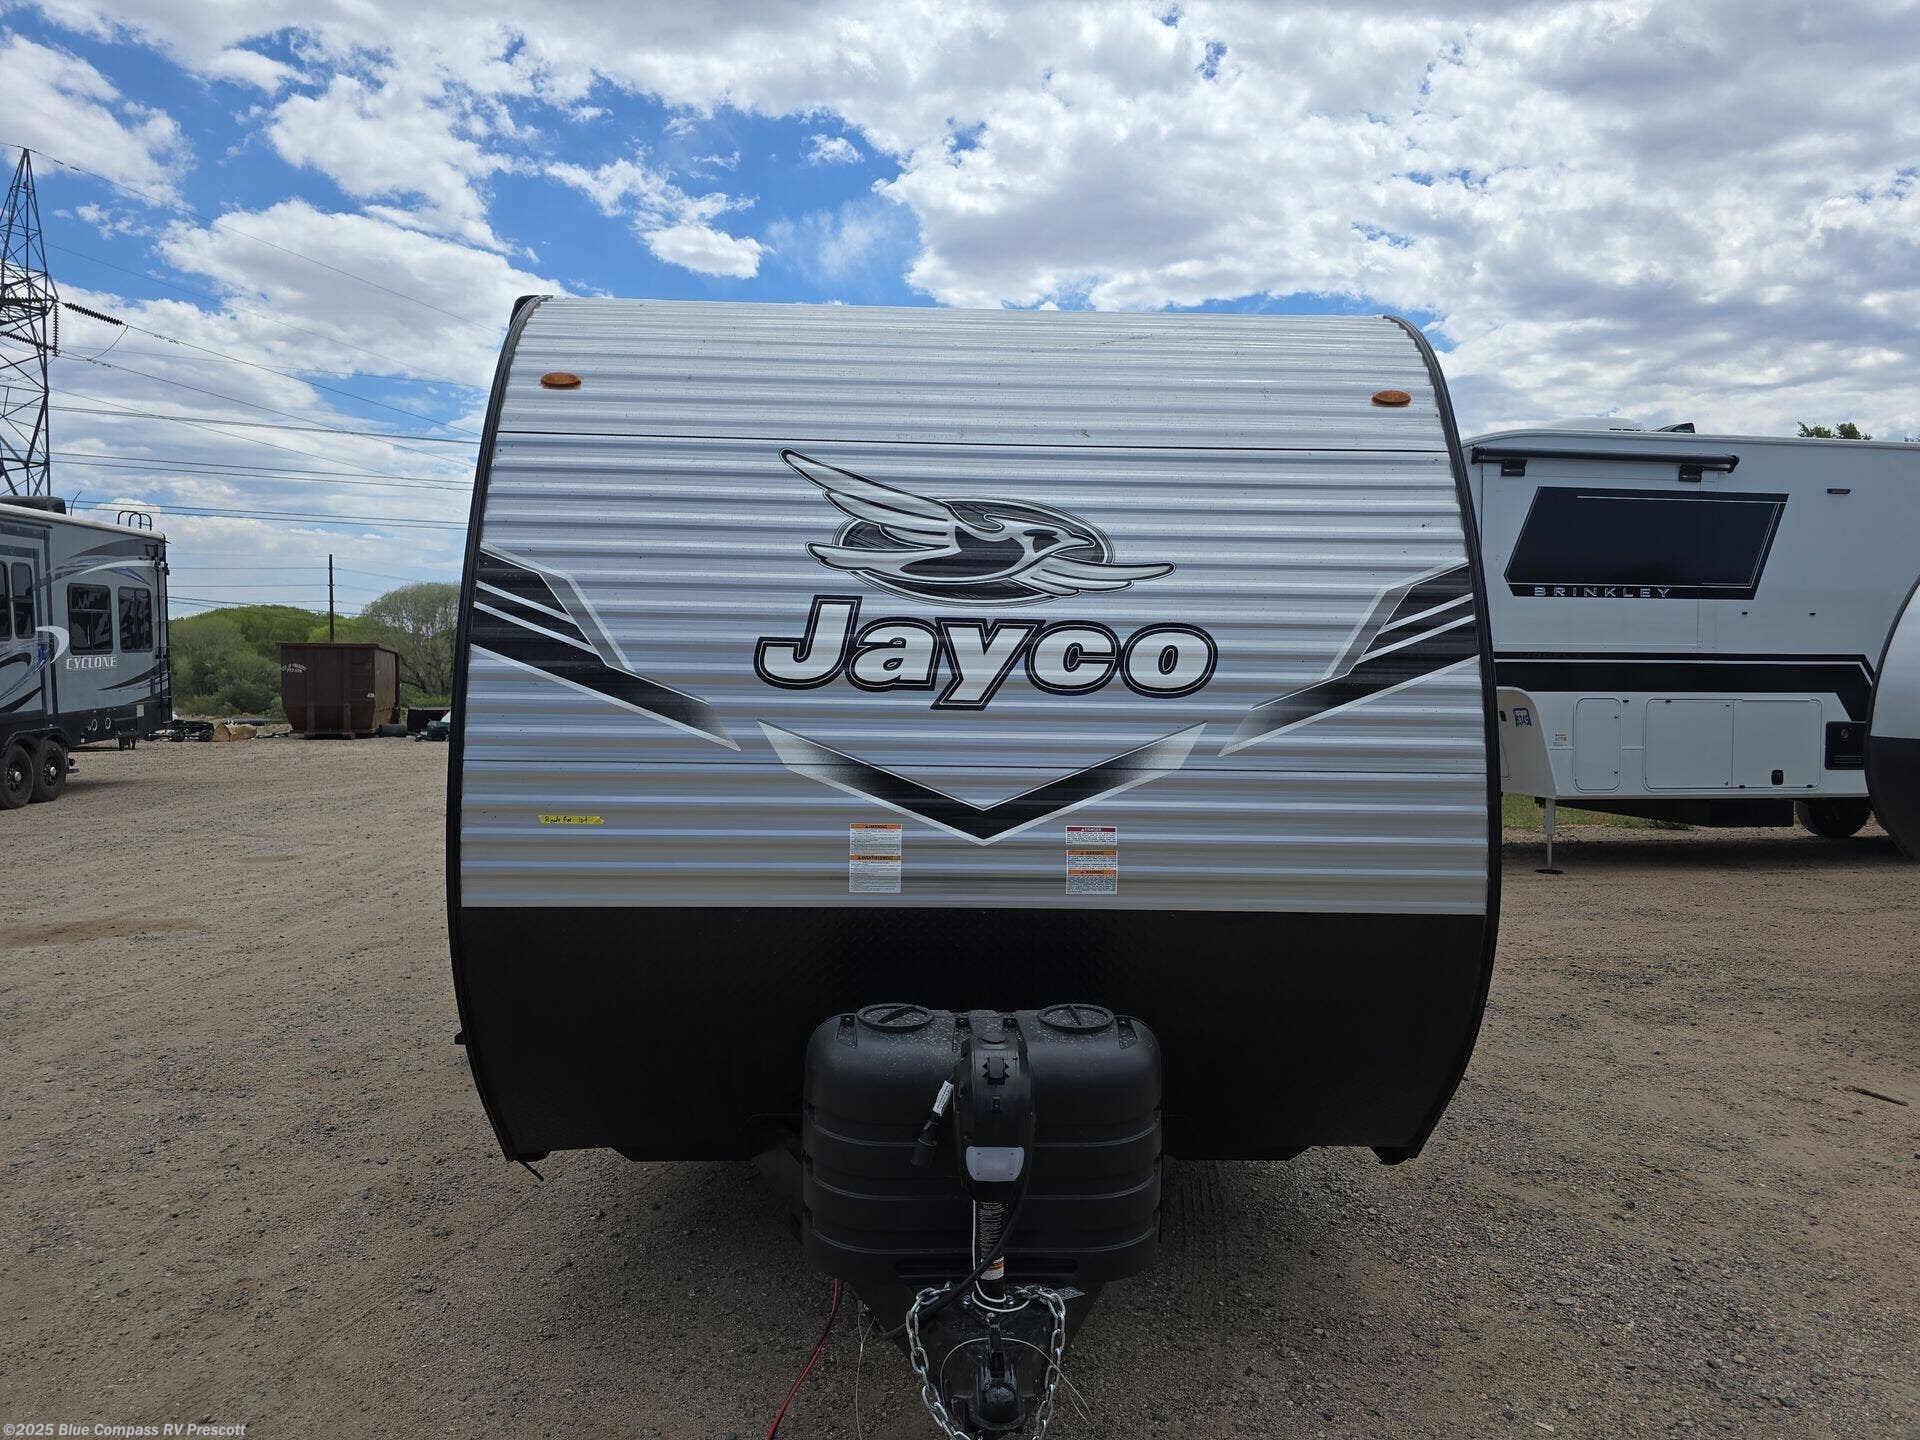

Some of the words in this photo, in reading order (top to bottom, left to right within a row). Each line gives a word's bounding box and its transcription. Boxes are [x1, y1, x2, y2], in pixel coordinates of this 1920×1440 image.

[1534, 587, 1670, 598] BRINKLEY
[753, 594, 1218, 711] Jayco
[66, 656, 117, 670] CYCLONE
